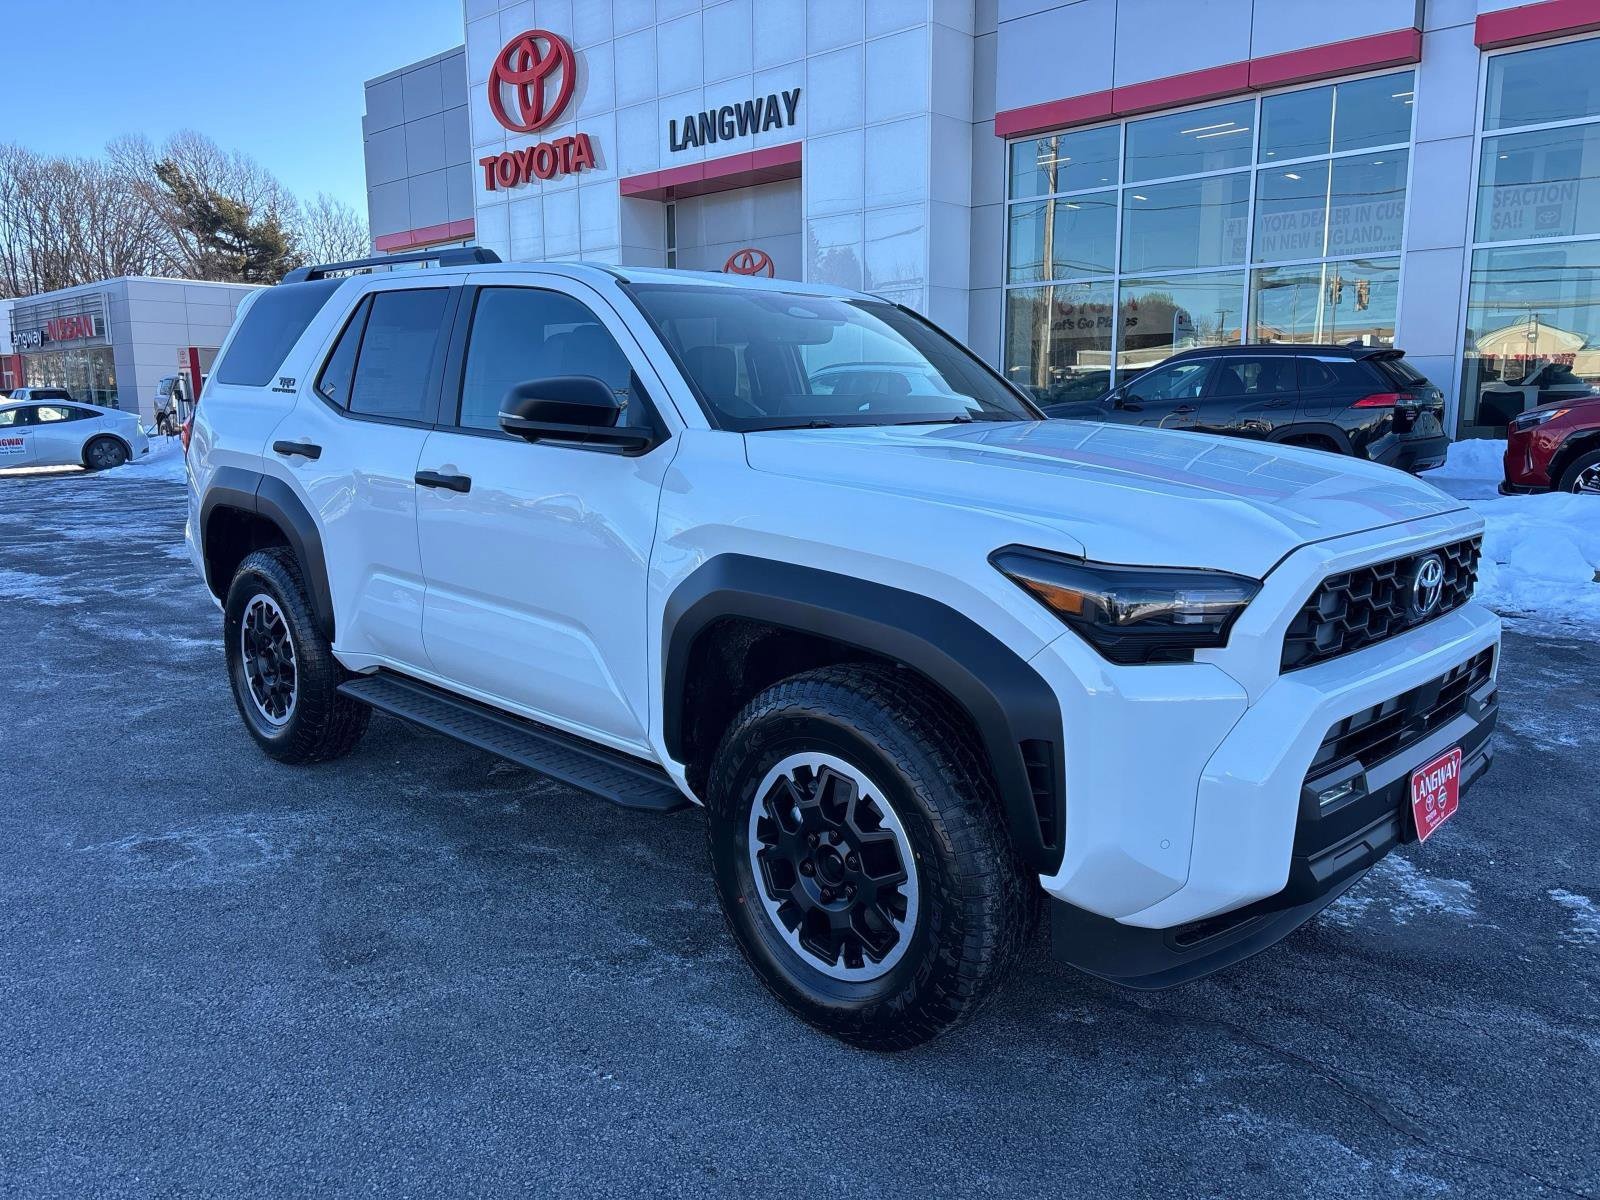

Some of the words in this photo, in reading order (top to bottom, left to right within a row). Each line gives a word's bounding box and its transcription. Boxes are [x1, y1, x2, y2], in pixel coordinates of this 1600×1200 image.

[669, 88, 800, 152] LANGWAY
[479, 133, 597, 190] TOYOTA
[1355, 205, 1371, 222] IN
[1261, 236, 1277, 252] IN
[1280, 232, 1310, 250] NEW
[11, 331, 42, 348] Langway
[47, 314, 96, 341] NISSAN
[1077, 317, 1095, 330] Go
[1097, 315, 1138, 330] Plaes
[0, 438, 24, 447] GWAY
[1413, 758, 1460, 805] LANGWAY
